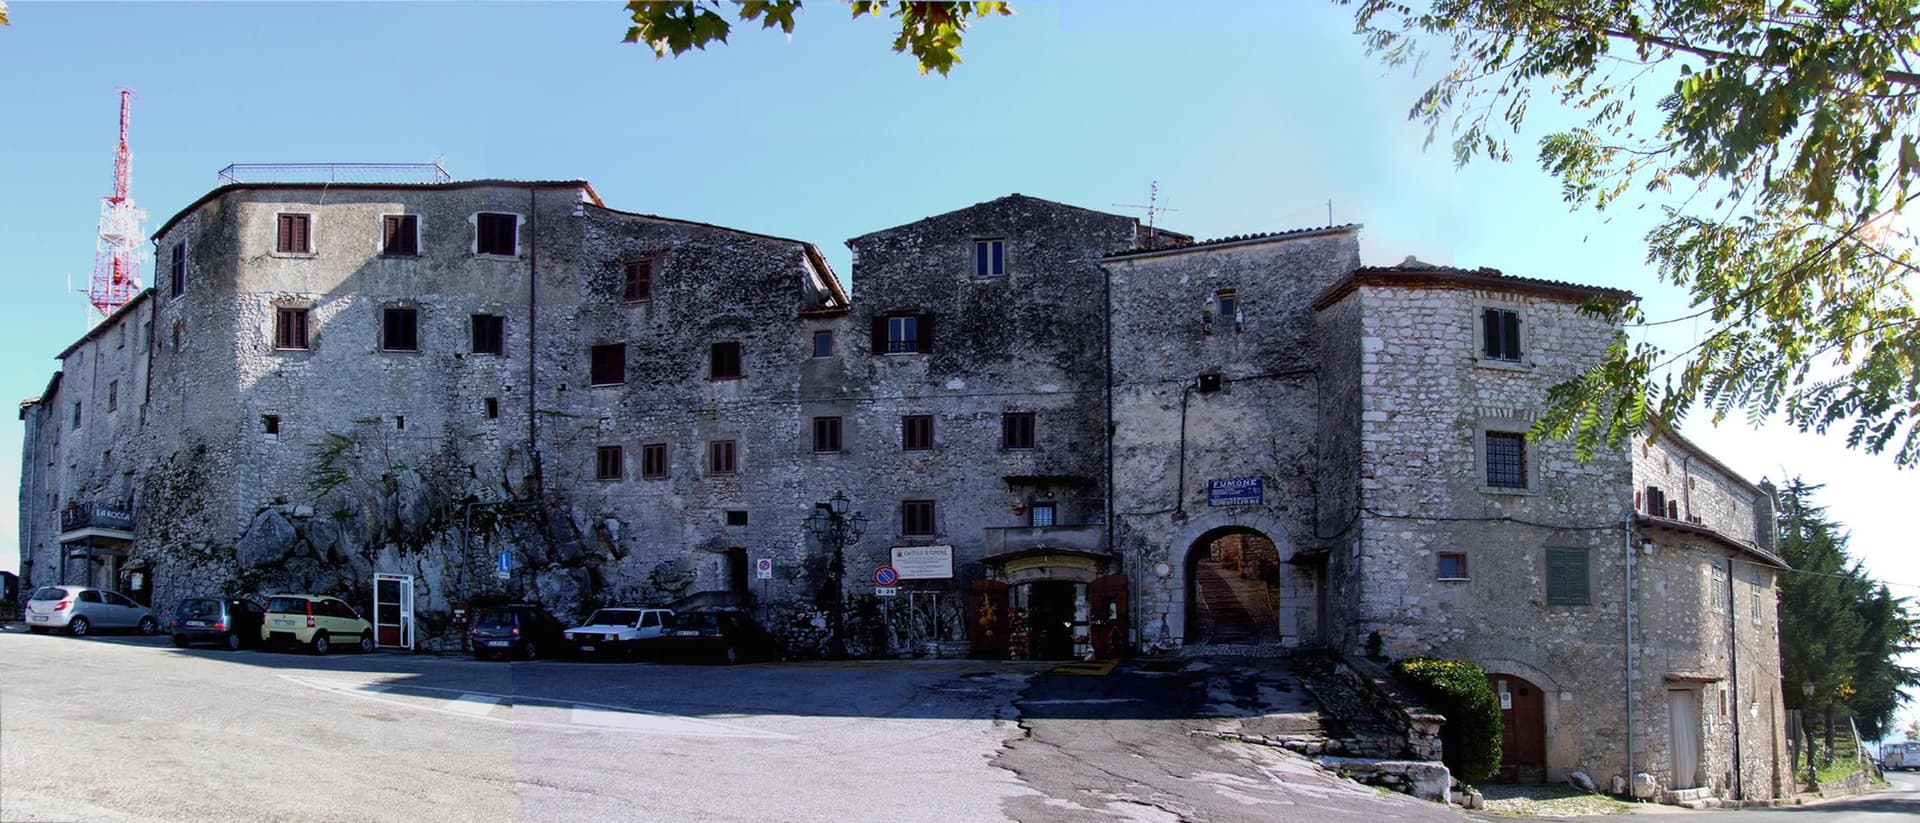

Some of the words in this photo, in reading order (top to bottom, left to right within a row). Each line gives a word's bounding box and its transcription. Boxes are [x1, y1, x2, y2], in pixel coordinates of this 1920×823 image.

[1213, 479, 1257, 488] FUMONE
[96, 509, 106, 517] LA
[107, 511, 130, 521] ROCCA
